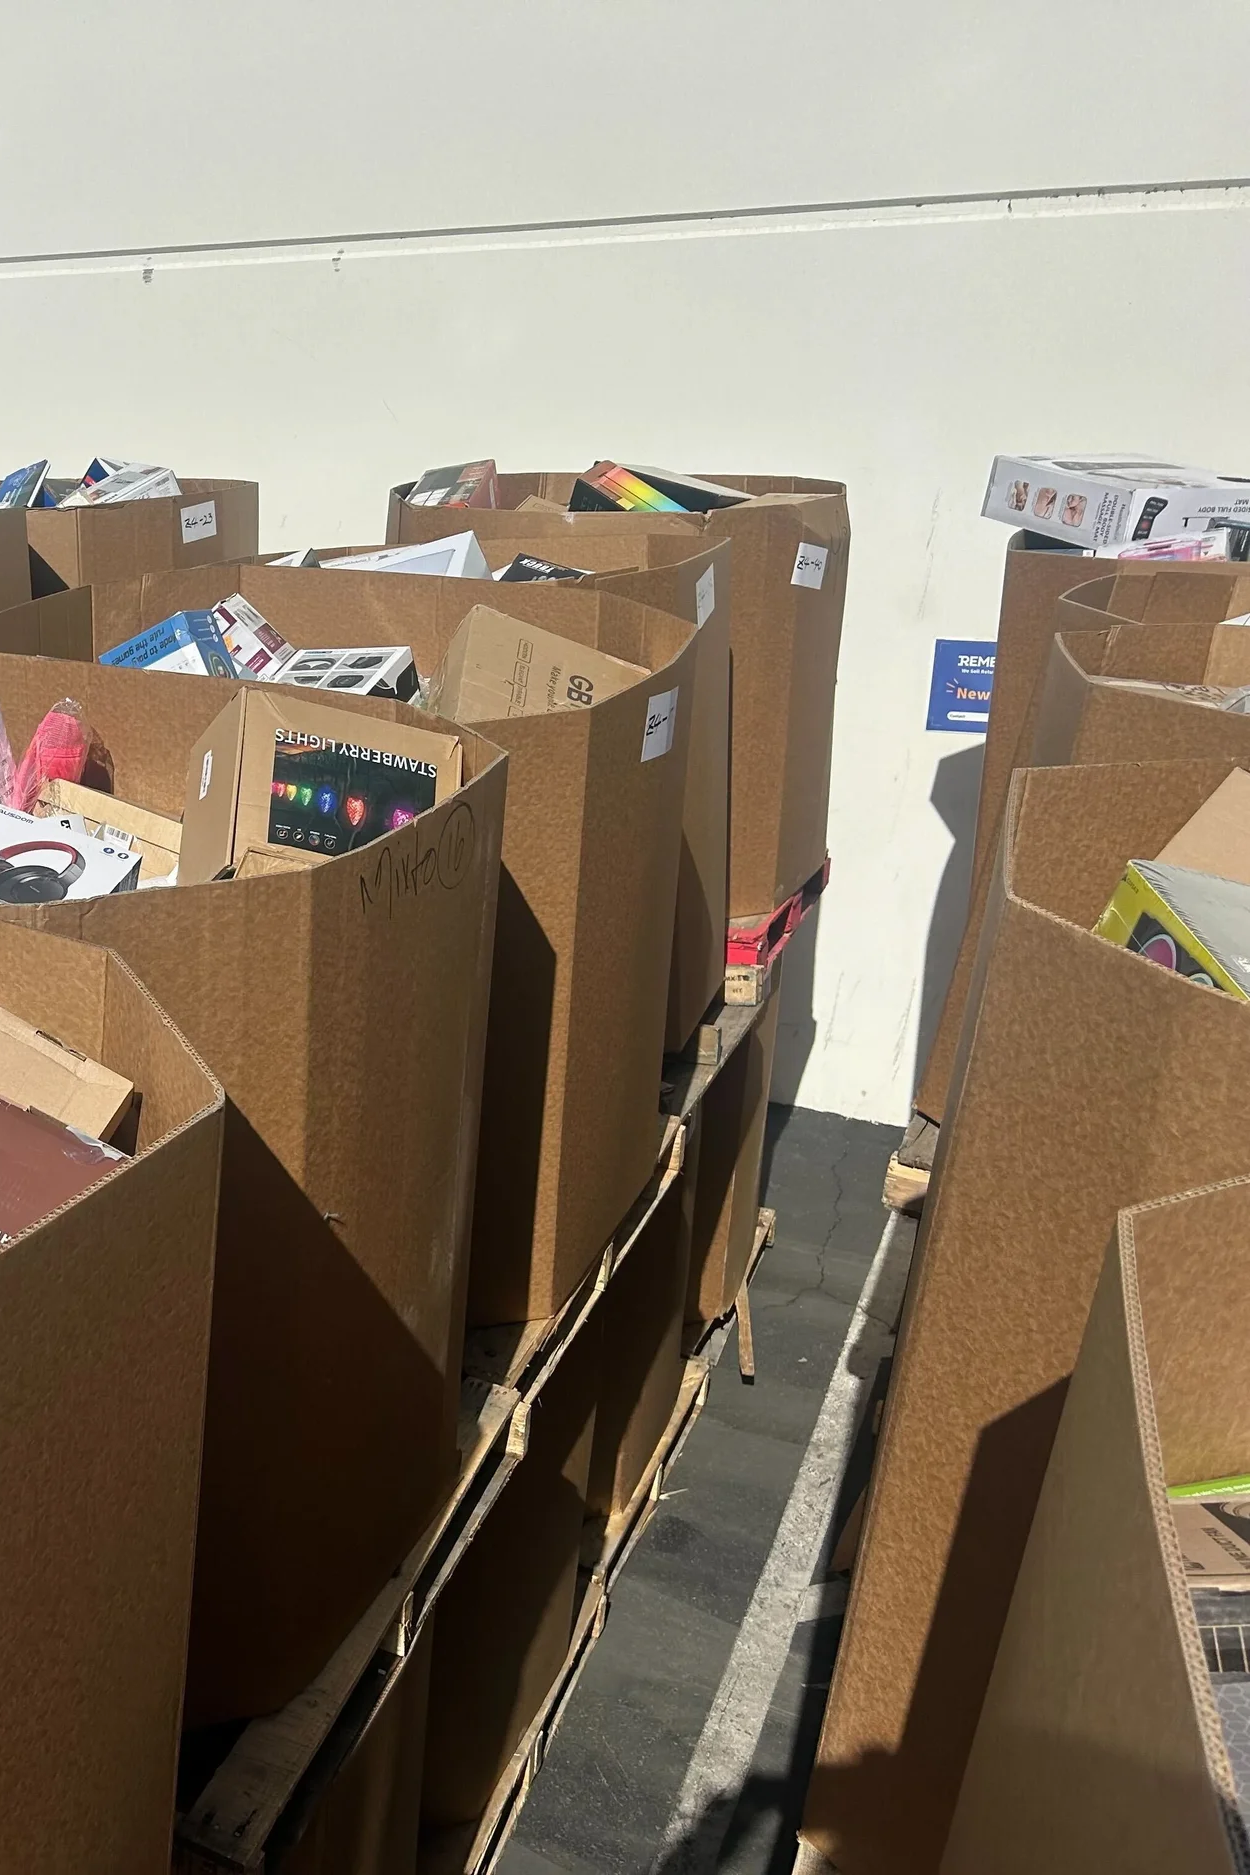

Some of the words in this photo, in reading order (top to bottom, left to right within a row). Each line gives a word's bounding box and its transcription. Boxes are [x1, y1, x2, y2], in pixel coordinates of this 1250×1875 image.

[519, 558, 554, 573] TRUCK
[149, 627, 165, 641] rule
[135, 639, 148, 651] the
[150, 646, 158, 656] to
[958, 655, 996, 667] REME
[549, 665, 562, 683] Make
[956, 687, 991, 700] New
[275, 728, 335, 752] LIGHTS
[339, 743, 437, 779] STAWBERRY
[360, 831, 436, 920] Mixto
